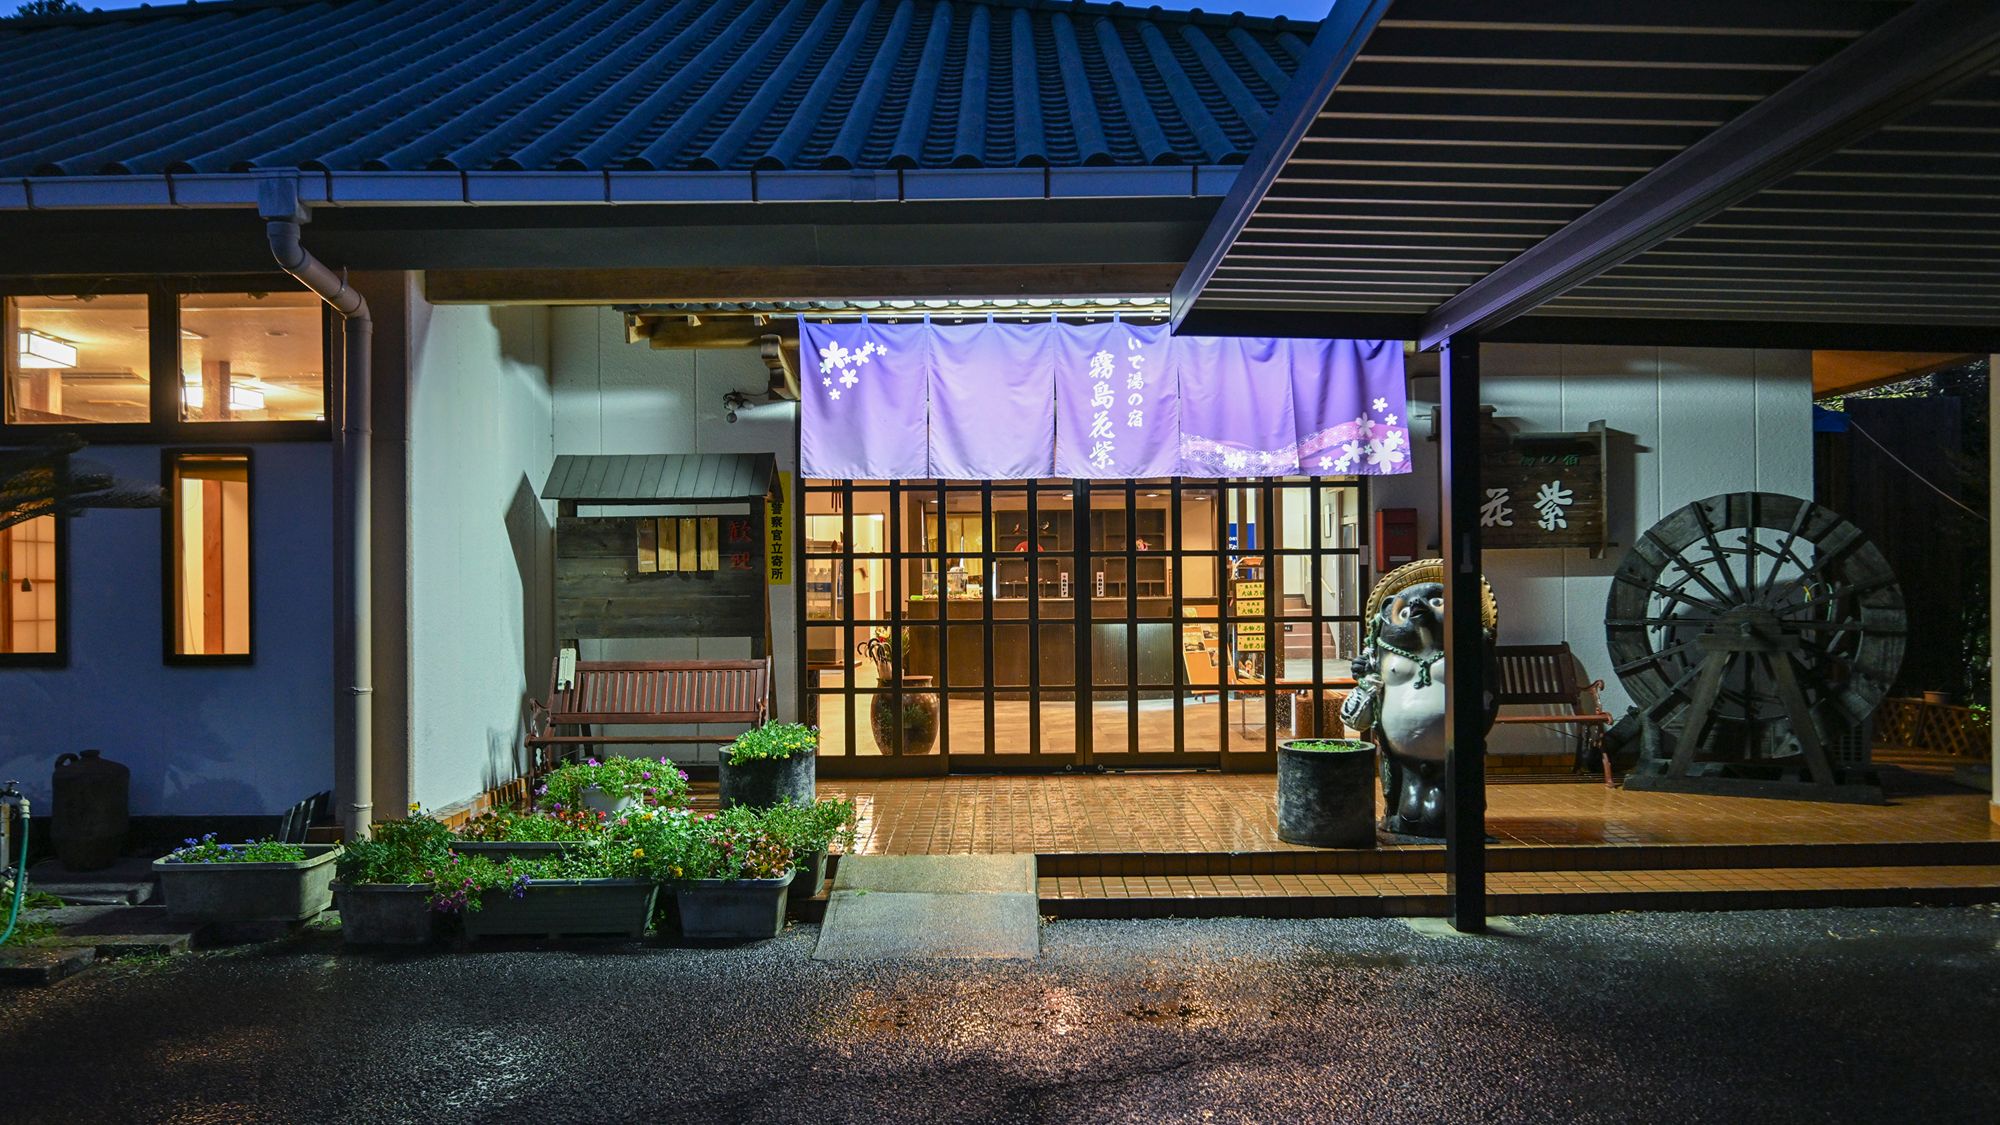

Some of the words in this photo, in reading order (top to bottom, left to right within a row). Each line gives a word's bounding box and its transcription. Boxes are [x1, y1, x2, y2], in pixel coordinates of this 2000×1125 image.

[1088, 350, 1116, 470] 霧島花紫
[1127, 336, 1145, 427] いで湯の宿
[770, 501, 784, 580] 警察官立寄所
[1480, 480, 1574, 532] 花紫
